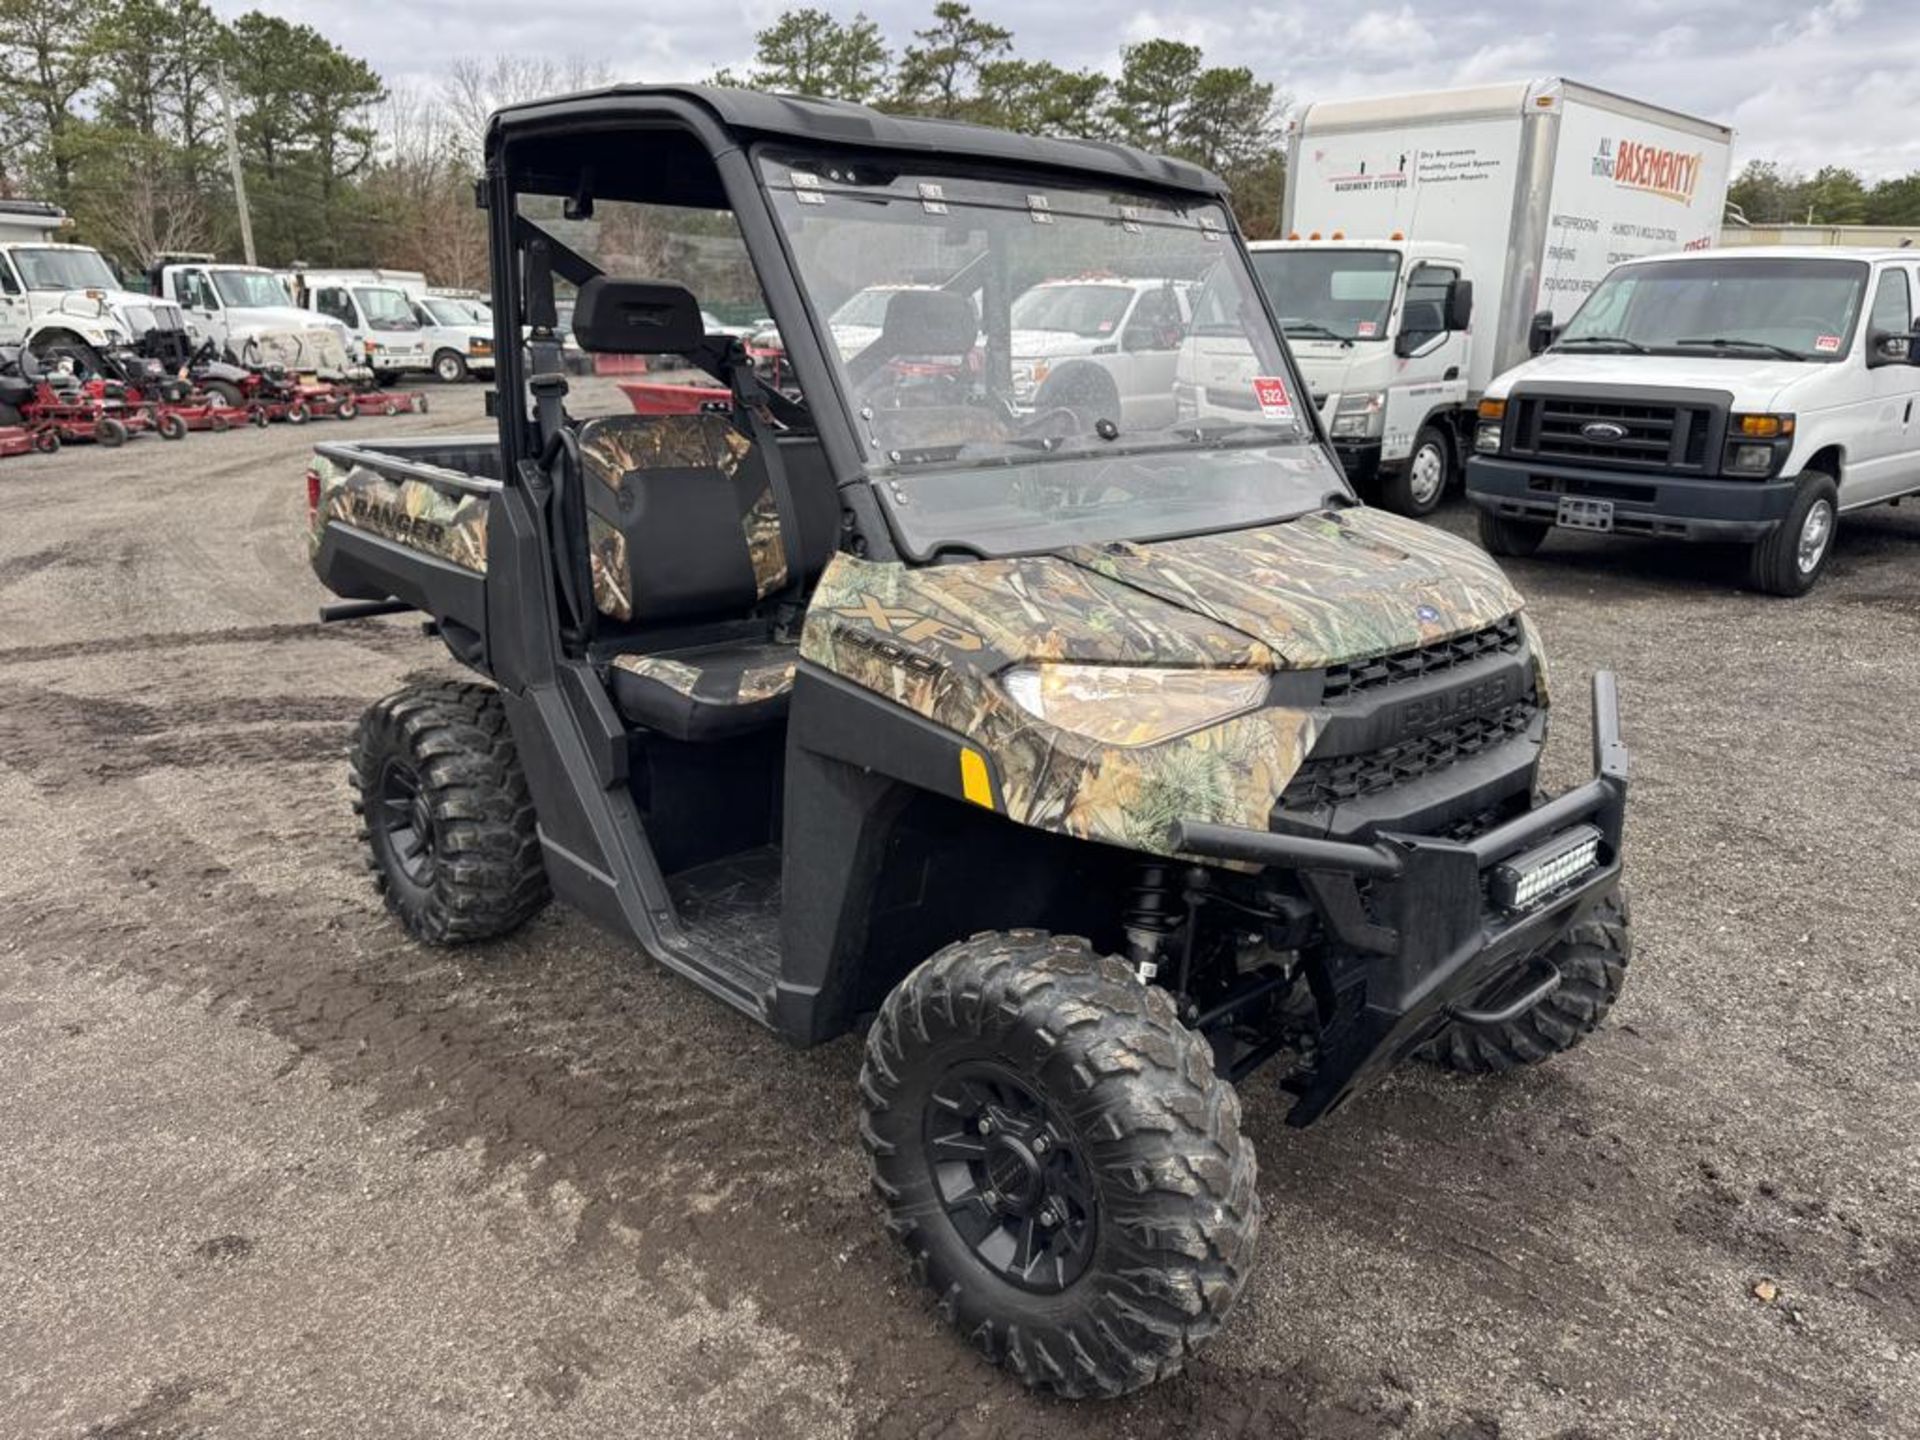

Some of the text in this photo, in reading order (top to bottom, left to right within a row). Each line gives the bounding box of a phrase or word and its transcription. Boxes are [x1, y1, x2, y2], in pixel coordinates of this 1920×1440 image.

[1420, 151, 1434, 159] Dry
[1599, 137, 1611, 156] ALL
[1335, 179, 1407, 192] BASEMENT SYSTEMS
[1262, 389, 1284, 403] 522
[352, 497, 445, 542] RANGER
[832, 590, 983, 652] XP
[1402, 677, 1506, 727] POLARIS
